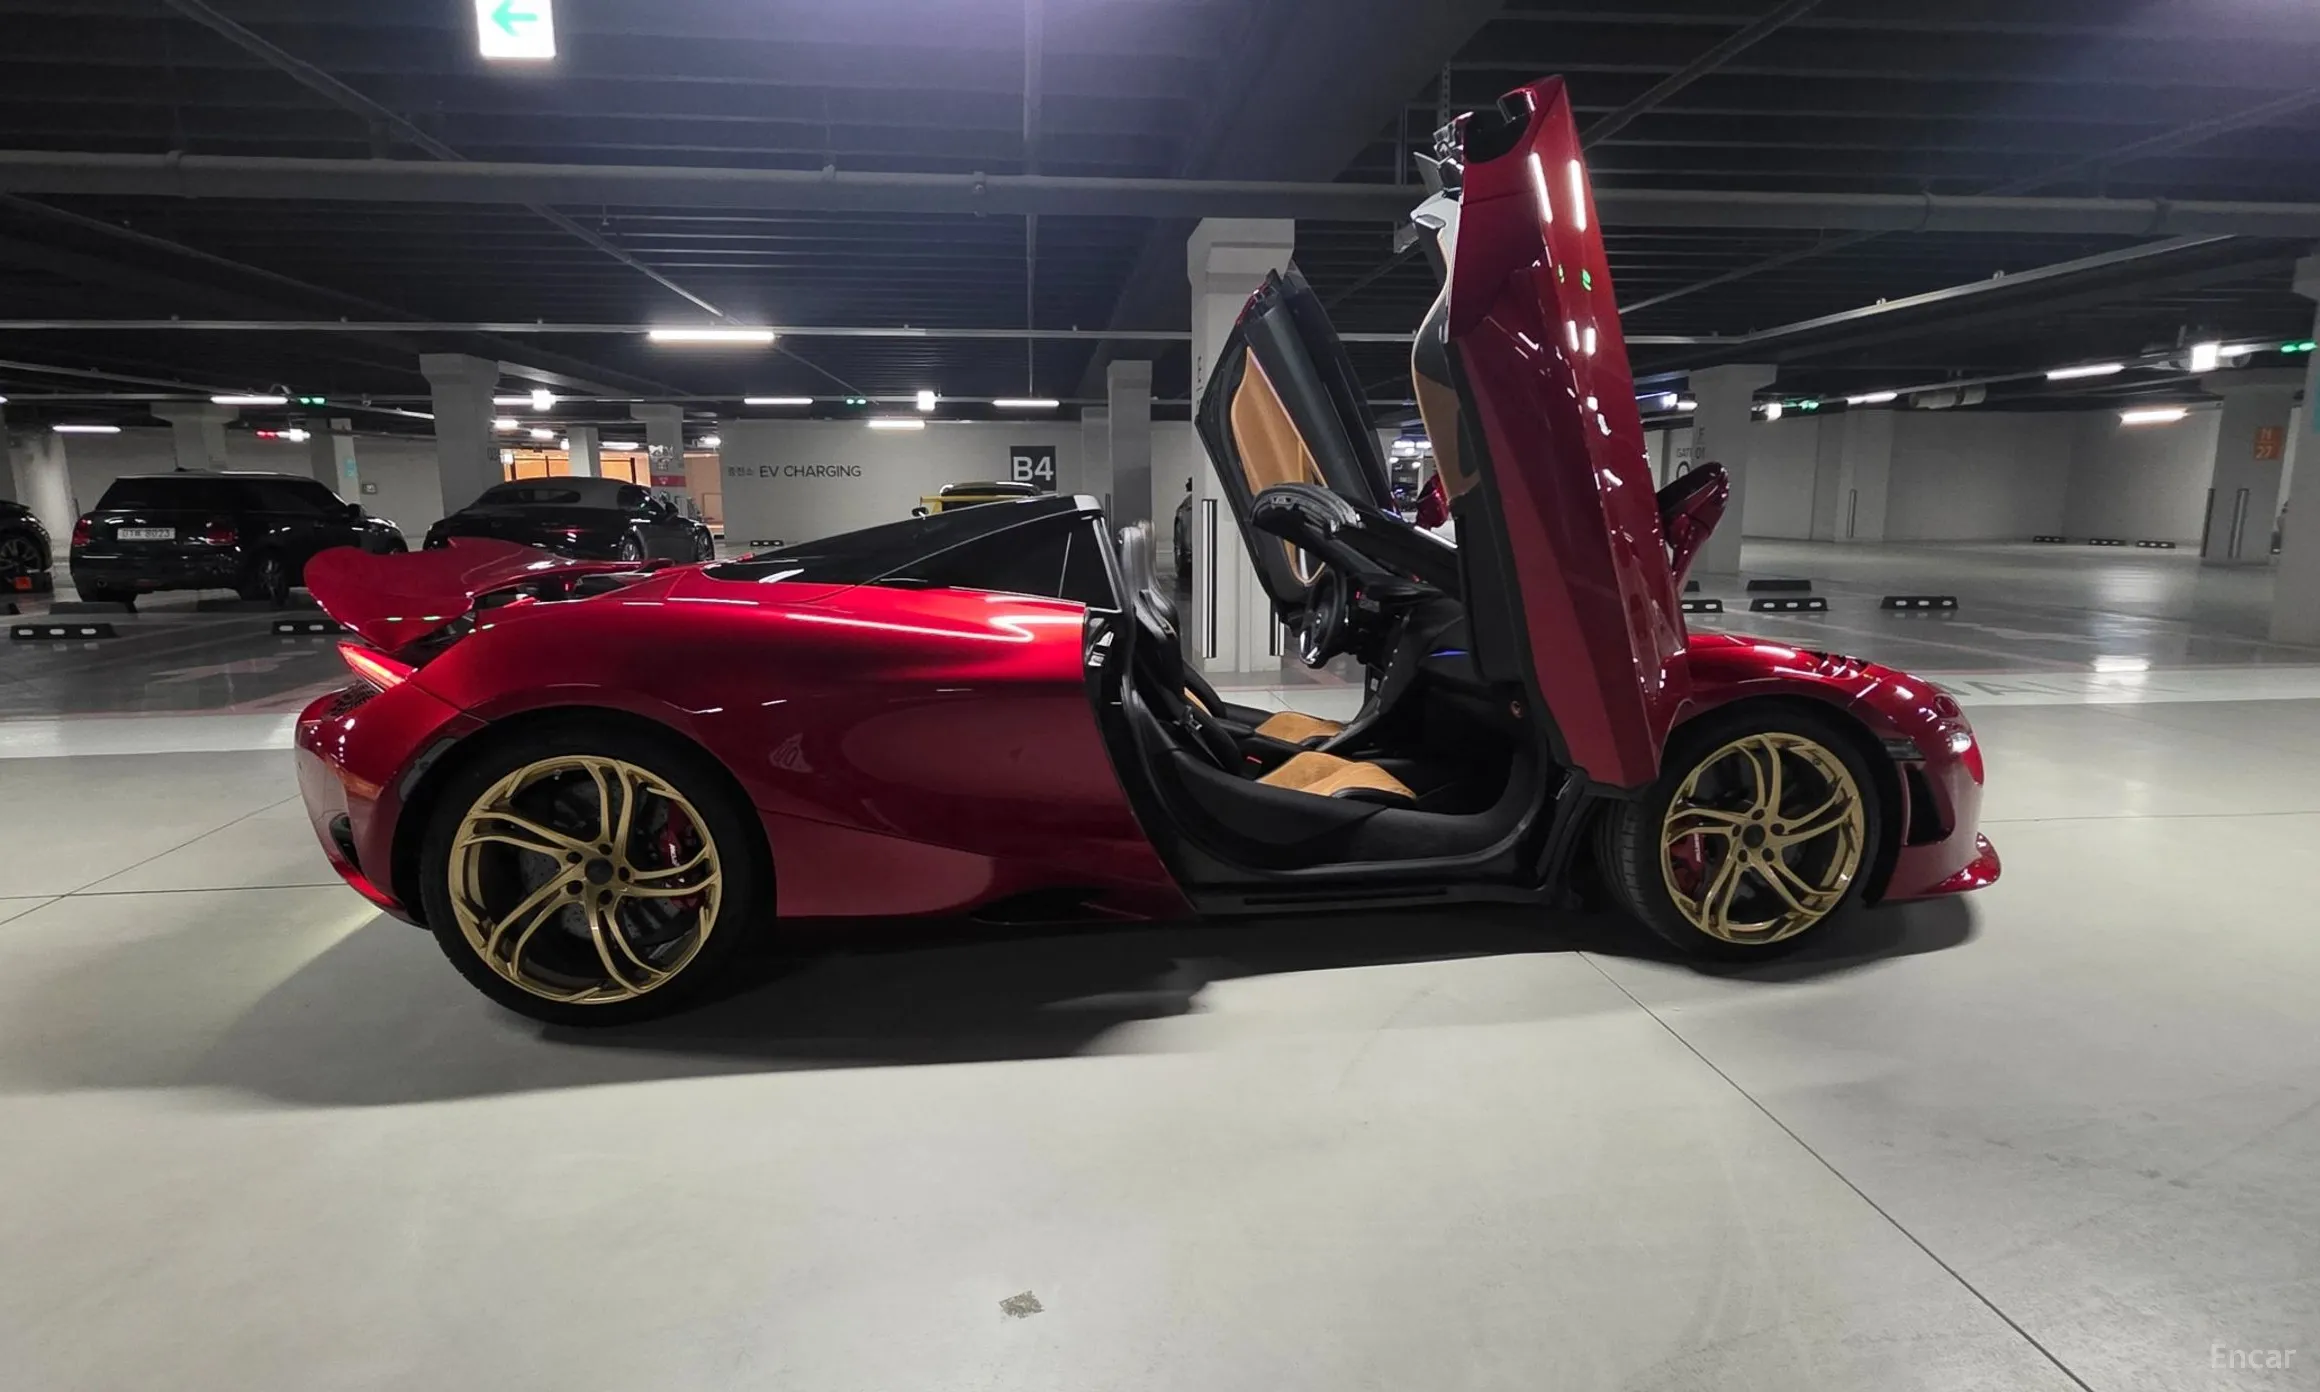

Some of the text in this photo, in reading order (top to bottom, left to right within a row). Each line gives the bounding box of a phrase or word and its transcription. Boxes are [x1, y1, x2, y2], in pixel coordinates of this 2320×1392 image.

[1676, 447, 1693, 458] GAT
[759, 465, 780, 478] EV
[783, 465, 862, 478] CHARGING
[1013, 456, 1054, 481] B4
